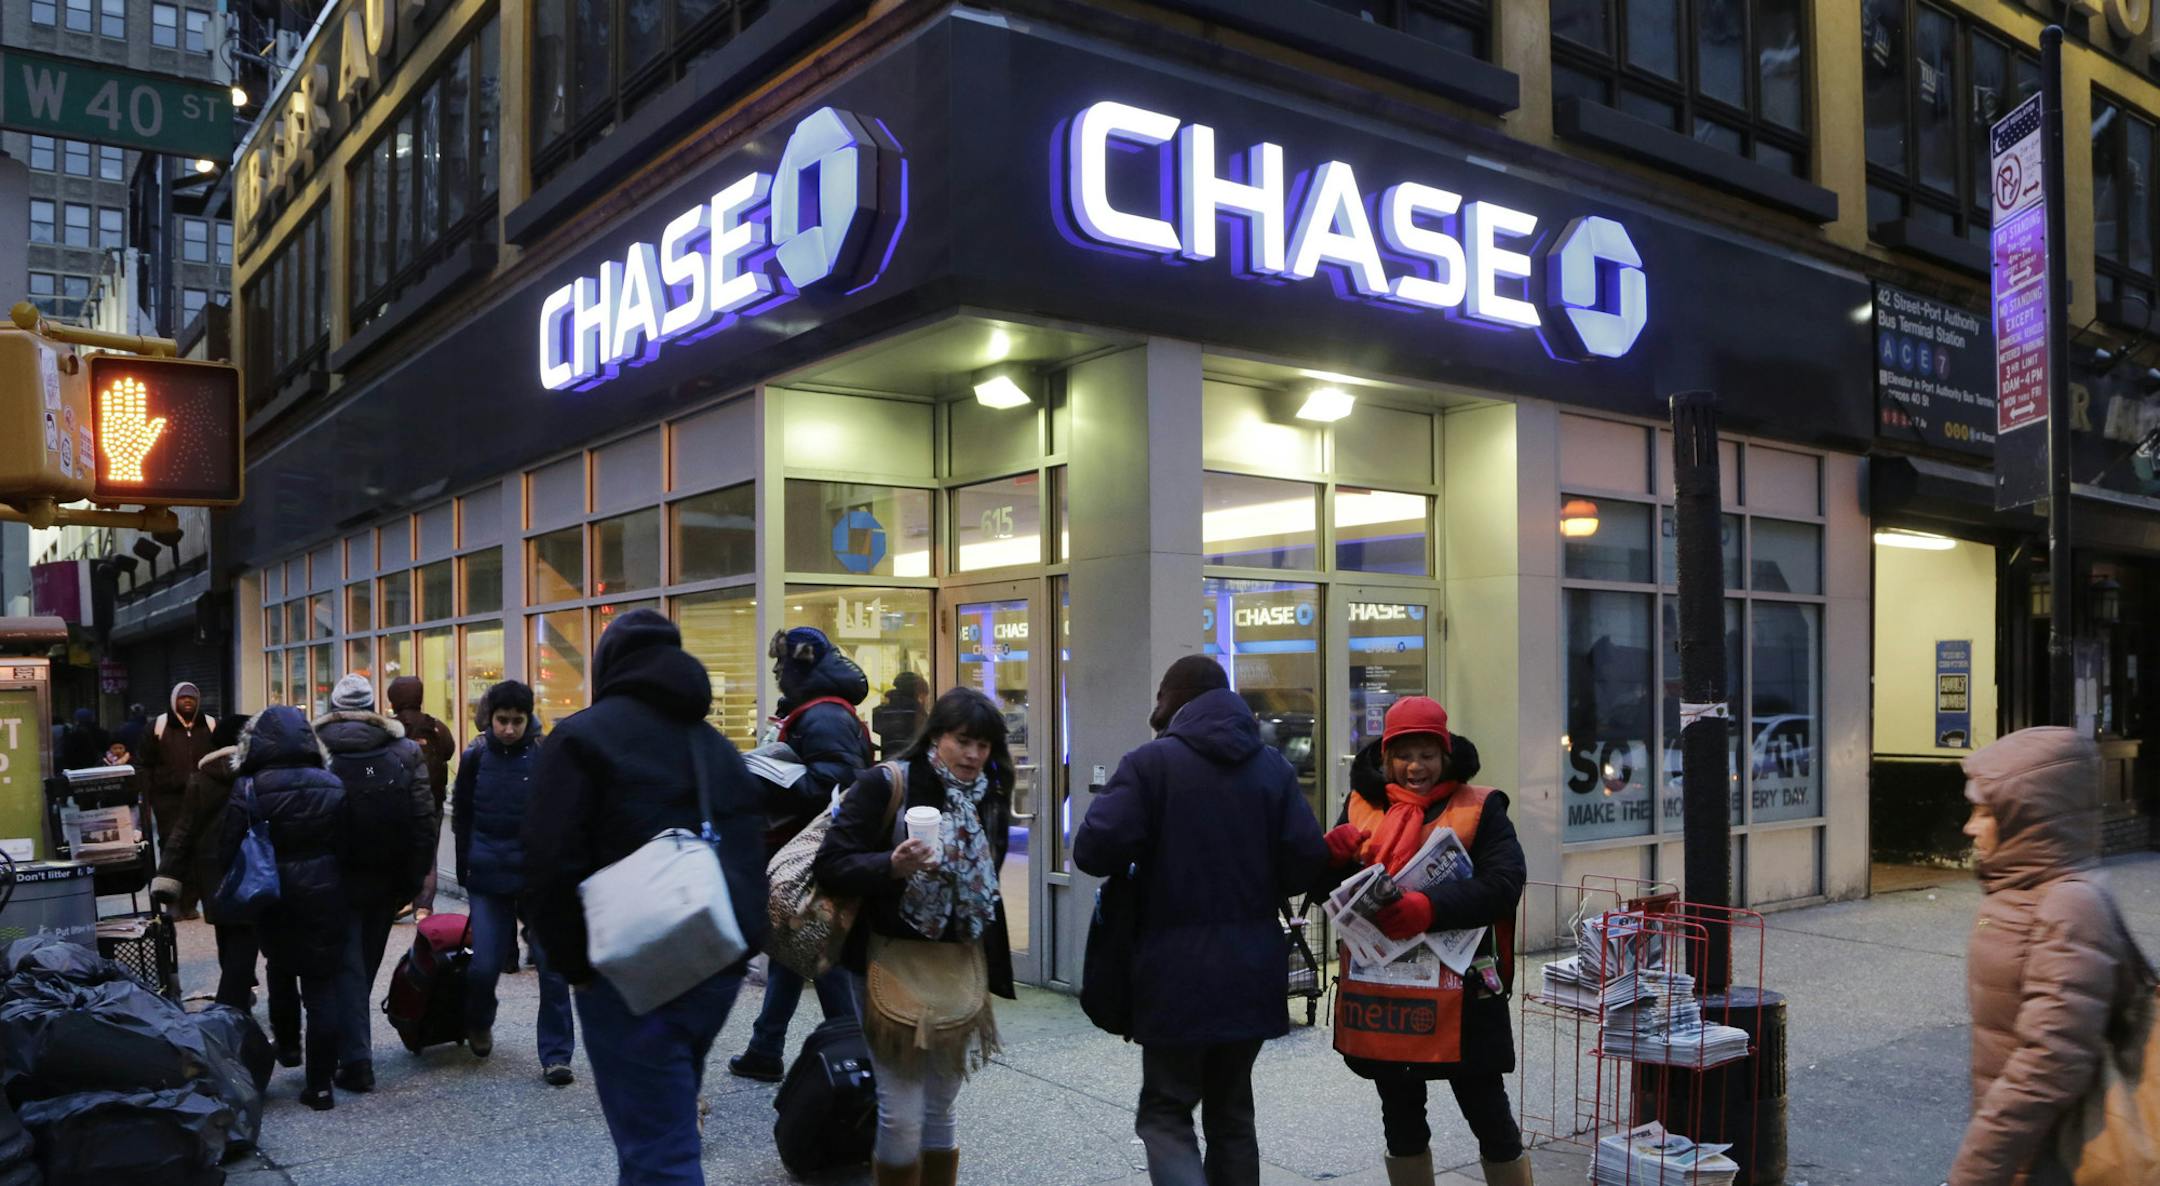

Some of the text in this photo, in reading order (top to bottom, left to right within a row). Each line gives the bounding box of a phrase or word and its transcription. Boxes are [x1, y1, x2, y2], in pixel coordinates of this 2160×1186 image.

[22, 65, 220, 137] W 40 ST
[1070, 101, 1542, 329] CHASE
[2010, 210, 2041, 239] STANDING
[540, 171, 775, 390] CHASE
[1878, 289, 1891, 306] 42
[1945, 309, 1979, 336] Authority
[1999, 286, 2042, 319] NO STANDING
[1878, 309, 1966, 348] Bus Terminal Station
[2006, 308, 2034, 332] EXCEPT
[1884, 340, 1946, 374] A C E 7
[2022, 353, 2038, 369] LIMIT
[981, 506, 1013, 539] 615
[1235, 606, 1295, 626] CHASE
[1568, 740, 1632, 794] SO
[1568, 803, 1615, 826] MAKE
[1621, 800, 1650, 822] THE
[16, 869, 71, 882] Don't litter
[55, 927, 70, 936] Put
[1344, 999, 1435, 1033] metro
